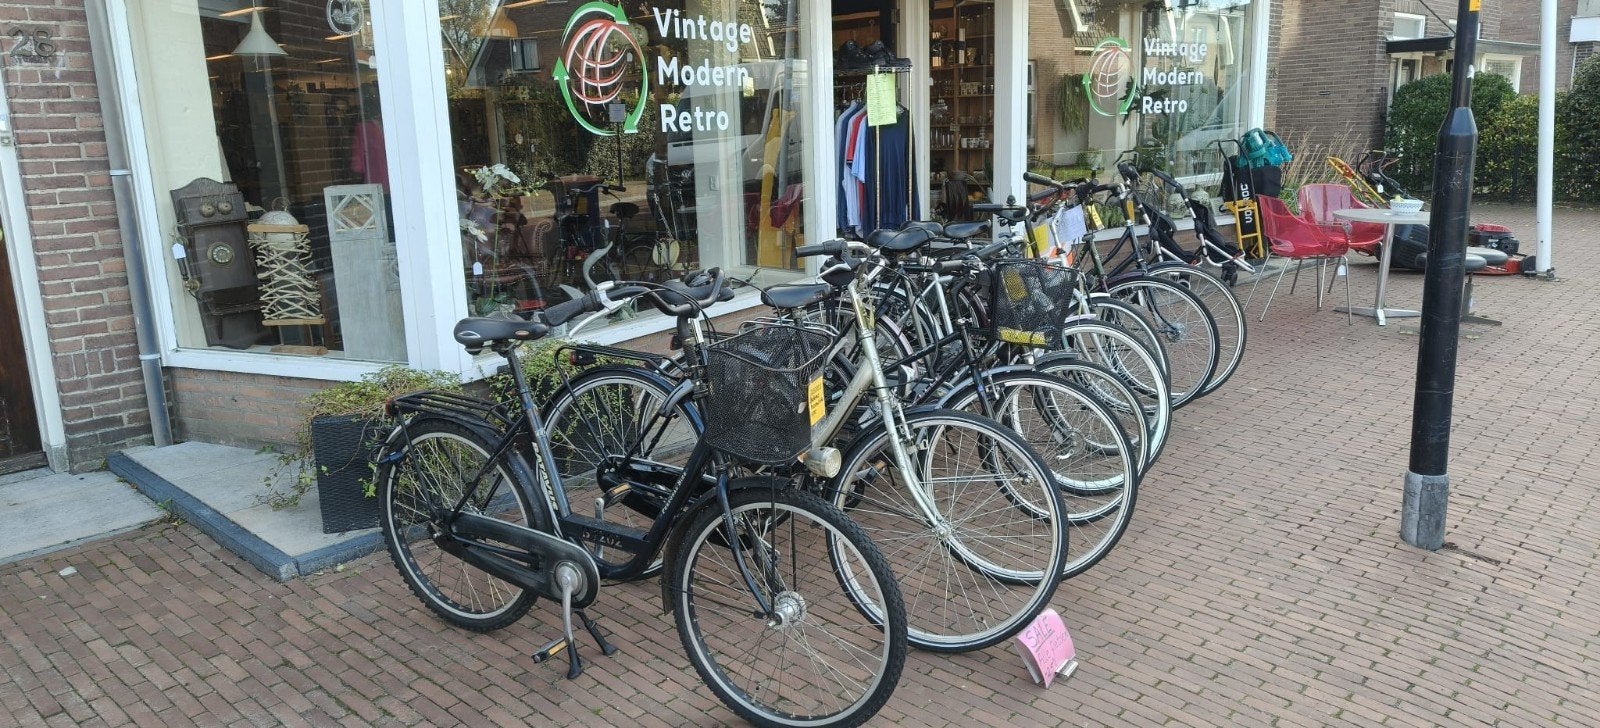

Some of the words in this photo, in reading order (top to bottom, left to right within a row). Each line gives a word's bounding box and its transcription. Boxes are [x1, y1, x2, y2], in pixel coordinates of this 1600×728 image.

[6, 26, 56, 58] 28
[652, 6, 751, 52] Vintage
[1143, 37, 1208, 63] Vintage
[657, 55, 750, 87] Modern
[1143, 66, 1204, 86] Modern
[660, 103, 729, 133] Retro
[1142, 95, 1188, 115] Retro
[1025, 615, 1053, 649] SALE
